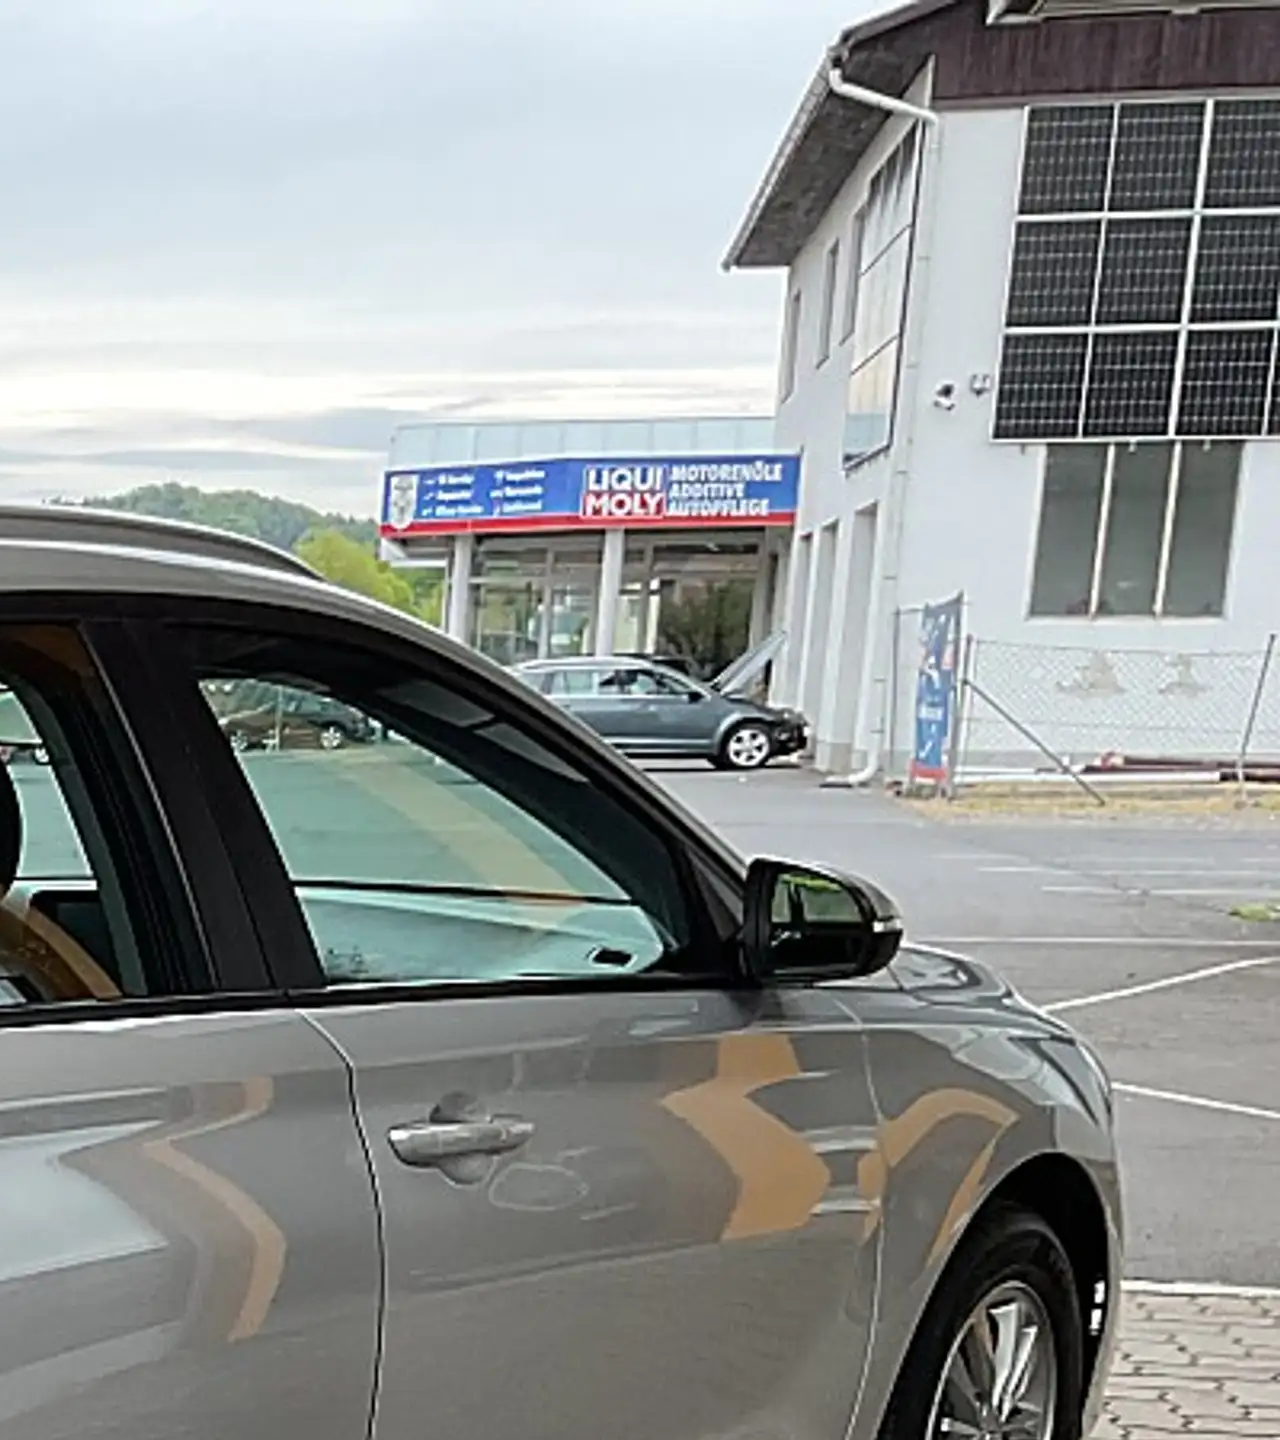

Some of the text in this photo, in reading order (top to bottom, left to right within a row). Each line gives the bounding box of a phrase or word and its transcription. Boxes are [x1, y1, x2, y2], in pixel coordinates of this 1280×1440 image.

[587, 466, 664, 491] LIQUI
[670, 460, 784, 482] MOTORENÖLE
[669, 482, 747, 500] ADDITIVE
[584, 491, 663, 516] MOLY
[667, 499, 771, 517] AUTOPFLEGE
